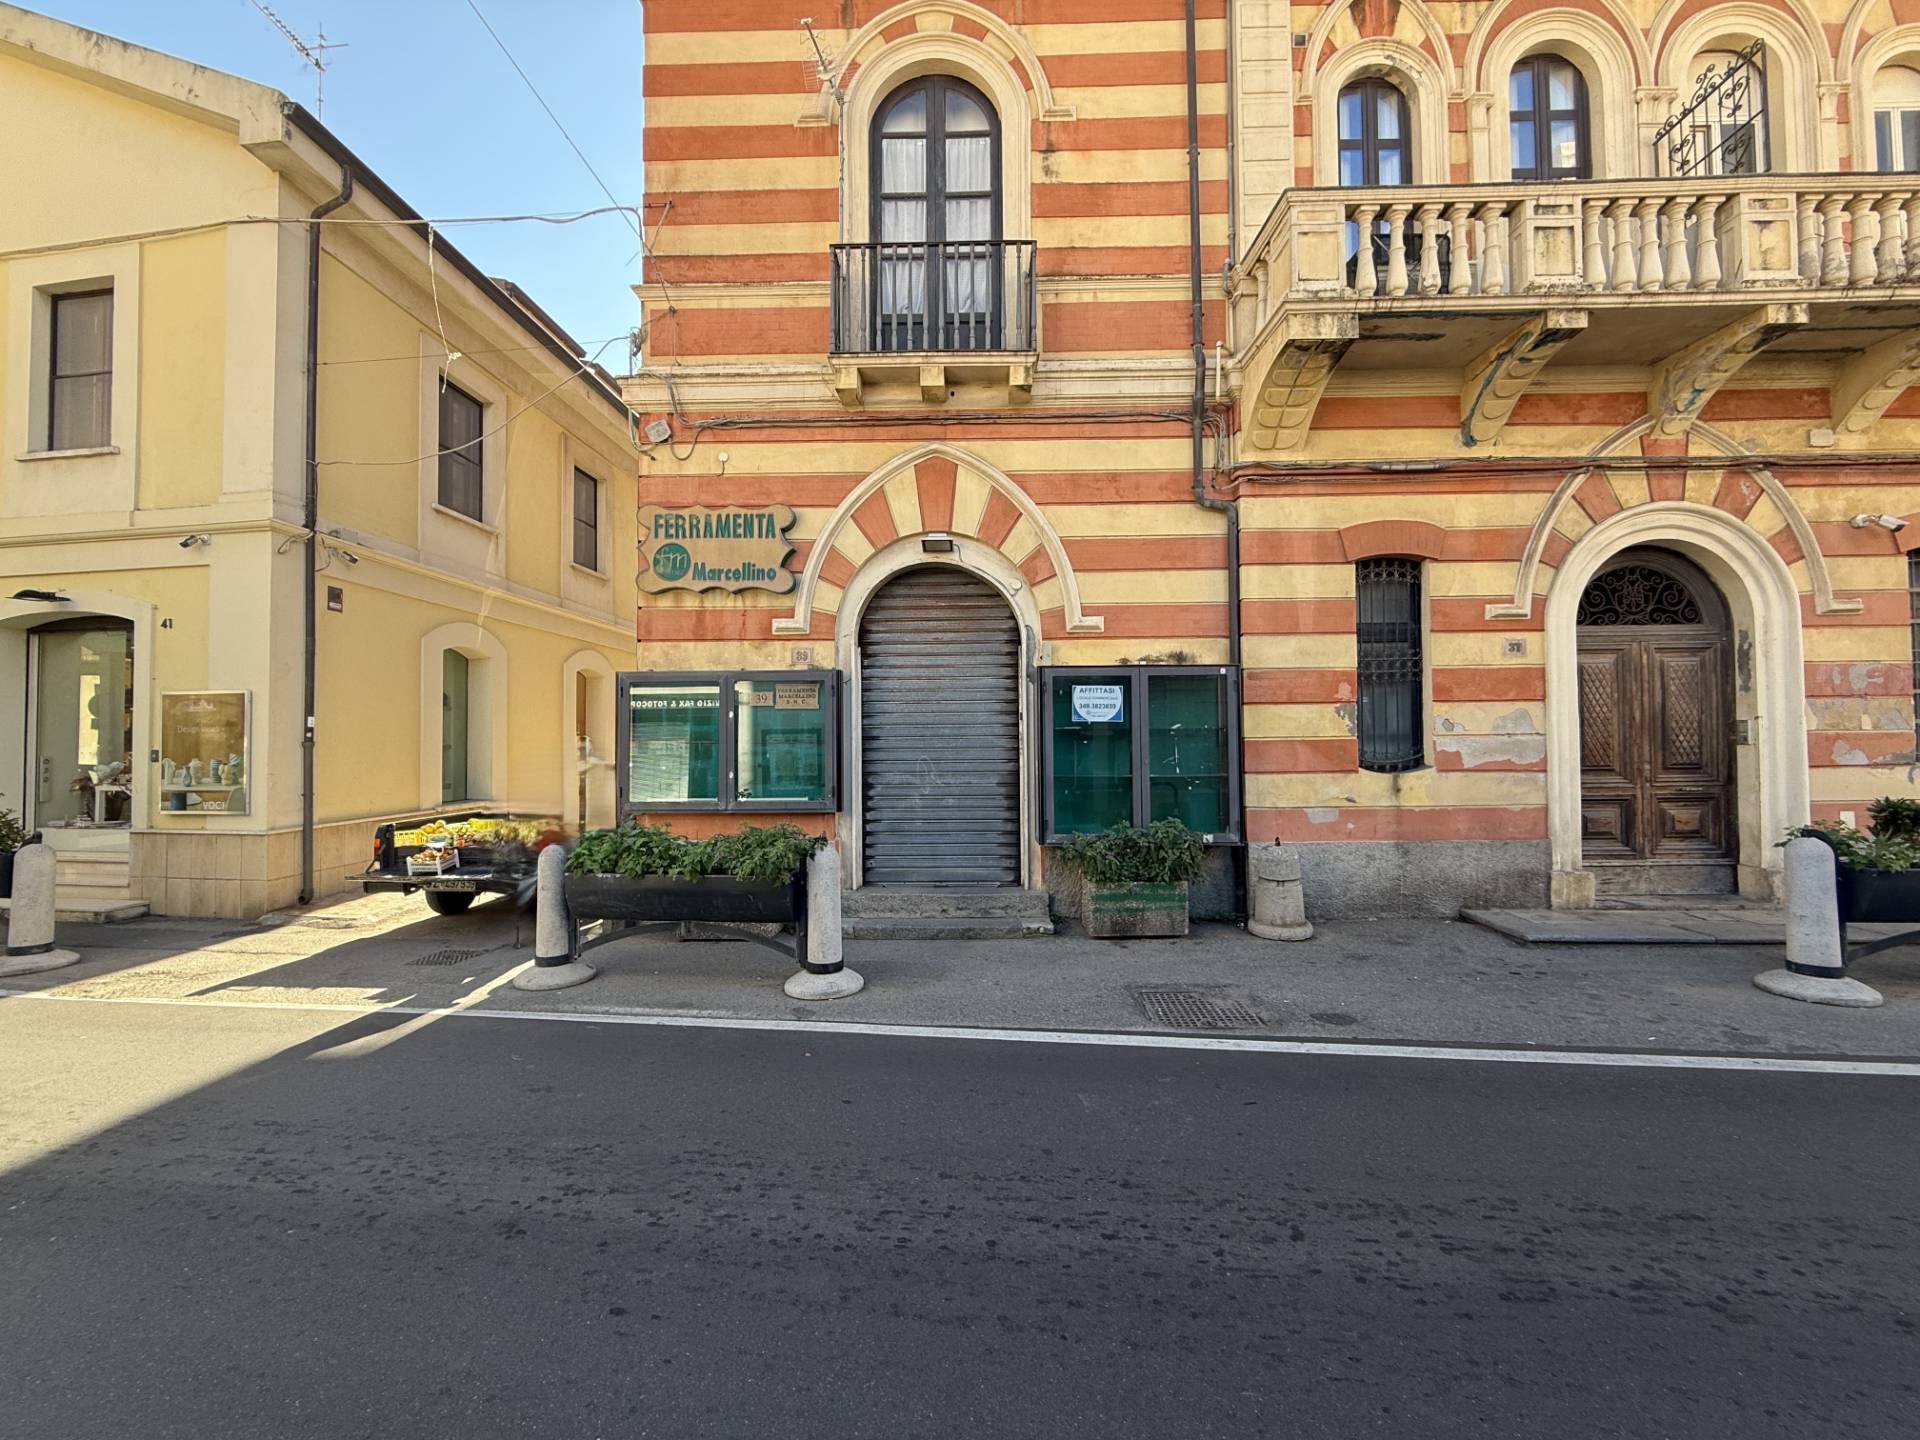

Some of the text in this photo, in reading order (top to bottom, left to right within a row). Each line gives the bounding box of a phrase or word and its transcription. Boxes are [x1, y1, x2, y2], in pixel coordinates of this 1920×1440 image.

[654, 513, 776, 539] FERRAMENTA
[692, 562, 777, 581] Marcellino
[160, 617, 173, 629] 41
[1508, 642, 1522, 652] 37
[755, 693, 768, 704] 39
